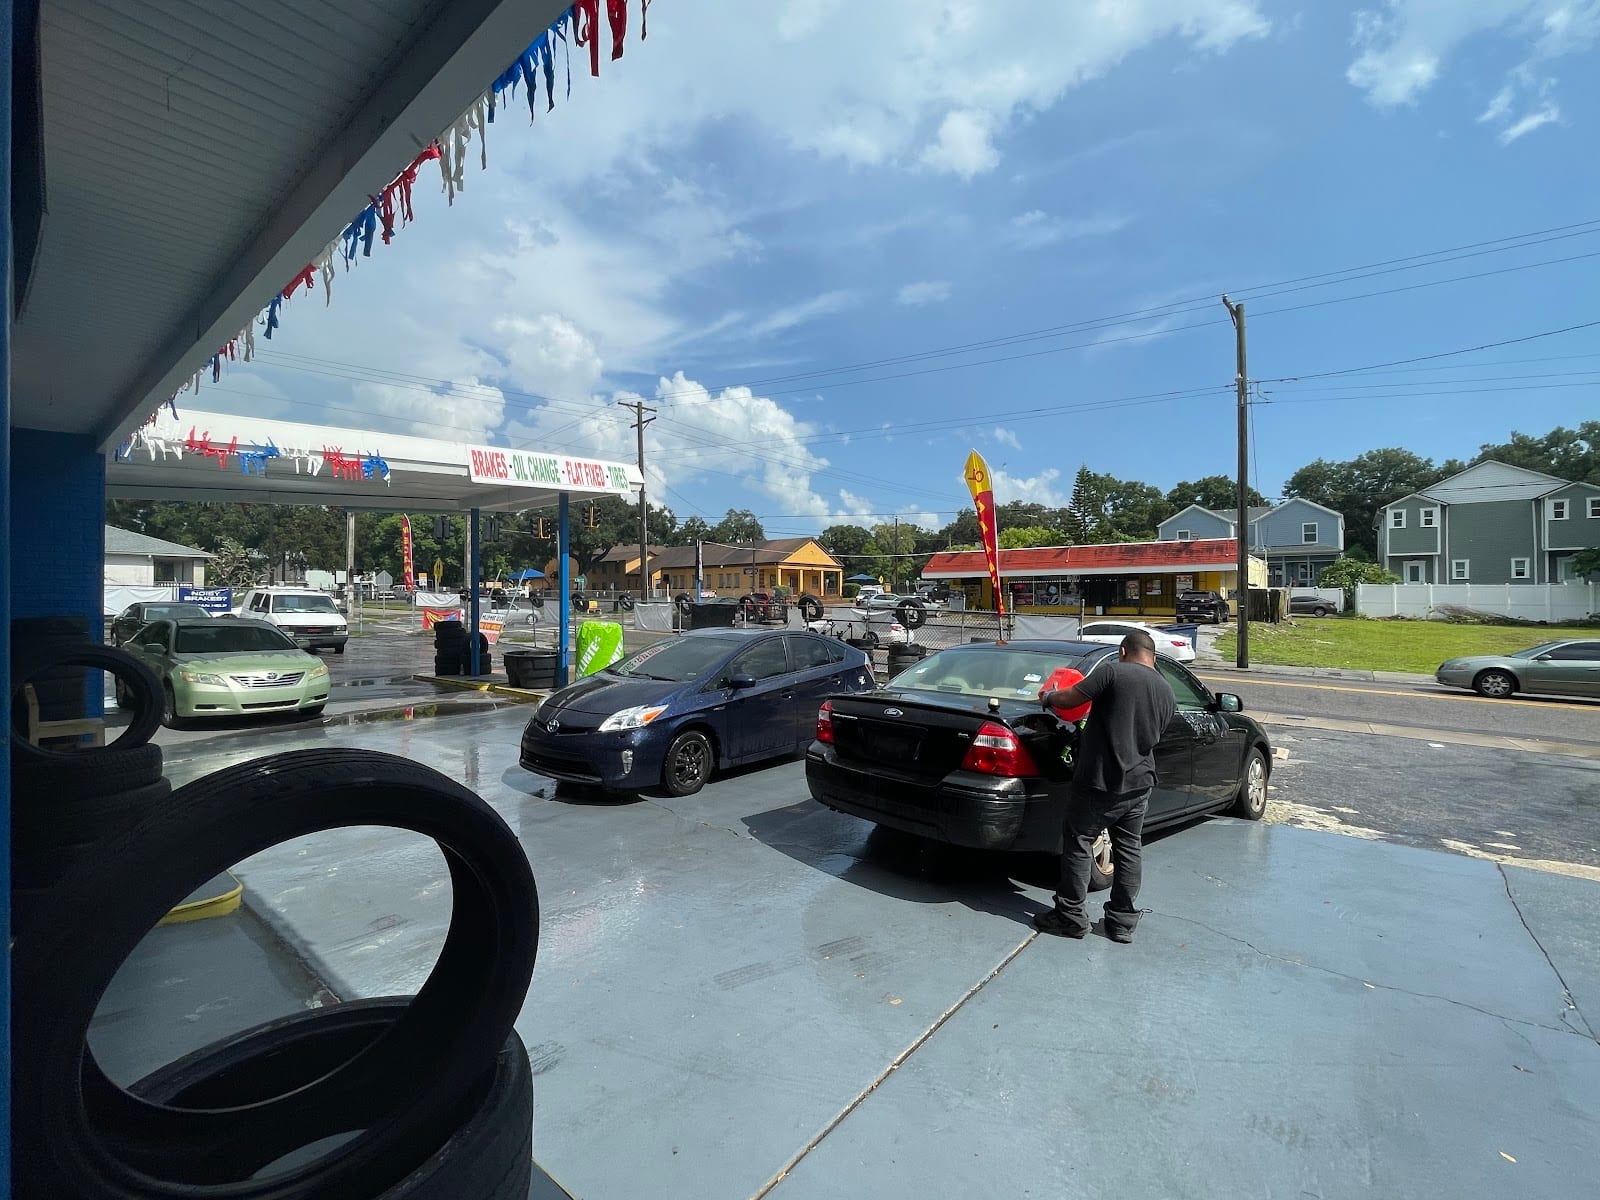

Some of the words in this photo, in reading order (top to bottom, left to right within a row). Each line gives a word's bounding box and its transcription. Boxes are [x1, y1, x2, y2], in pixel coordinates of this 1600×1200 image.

[471, 450, 508, 479] BRAKES
[513, 455, 528, 480] OIL
[528, 457, 561, 483] CHANGE
[565, 461, 585, 486] FLAT
[583, 463, 605, 487] FIXED
[608, 466, 629, 489] TIRES
